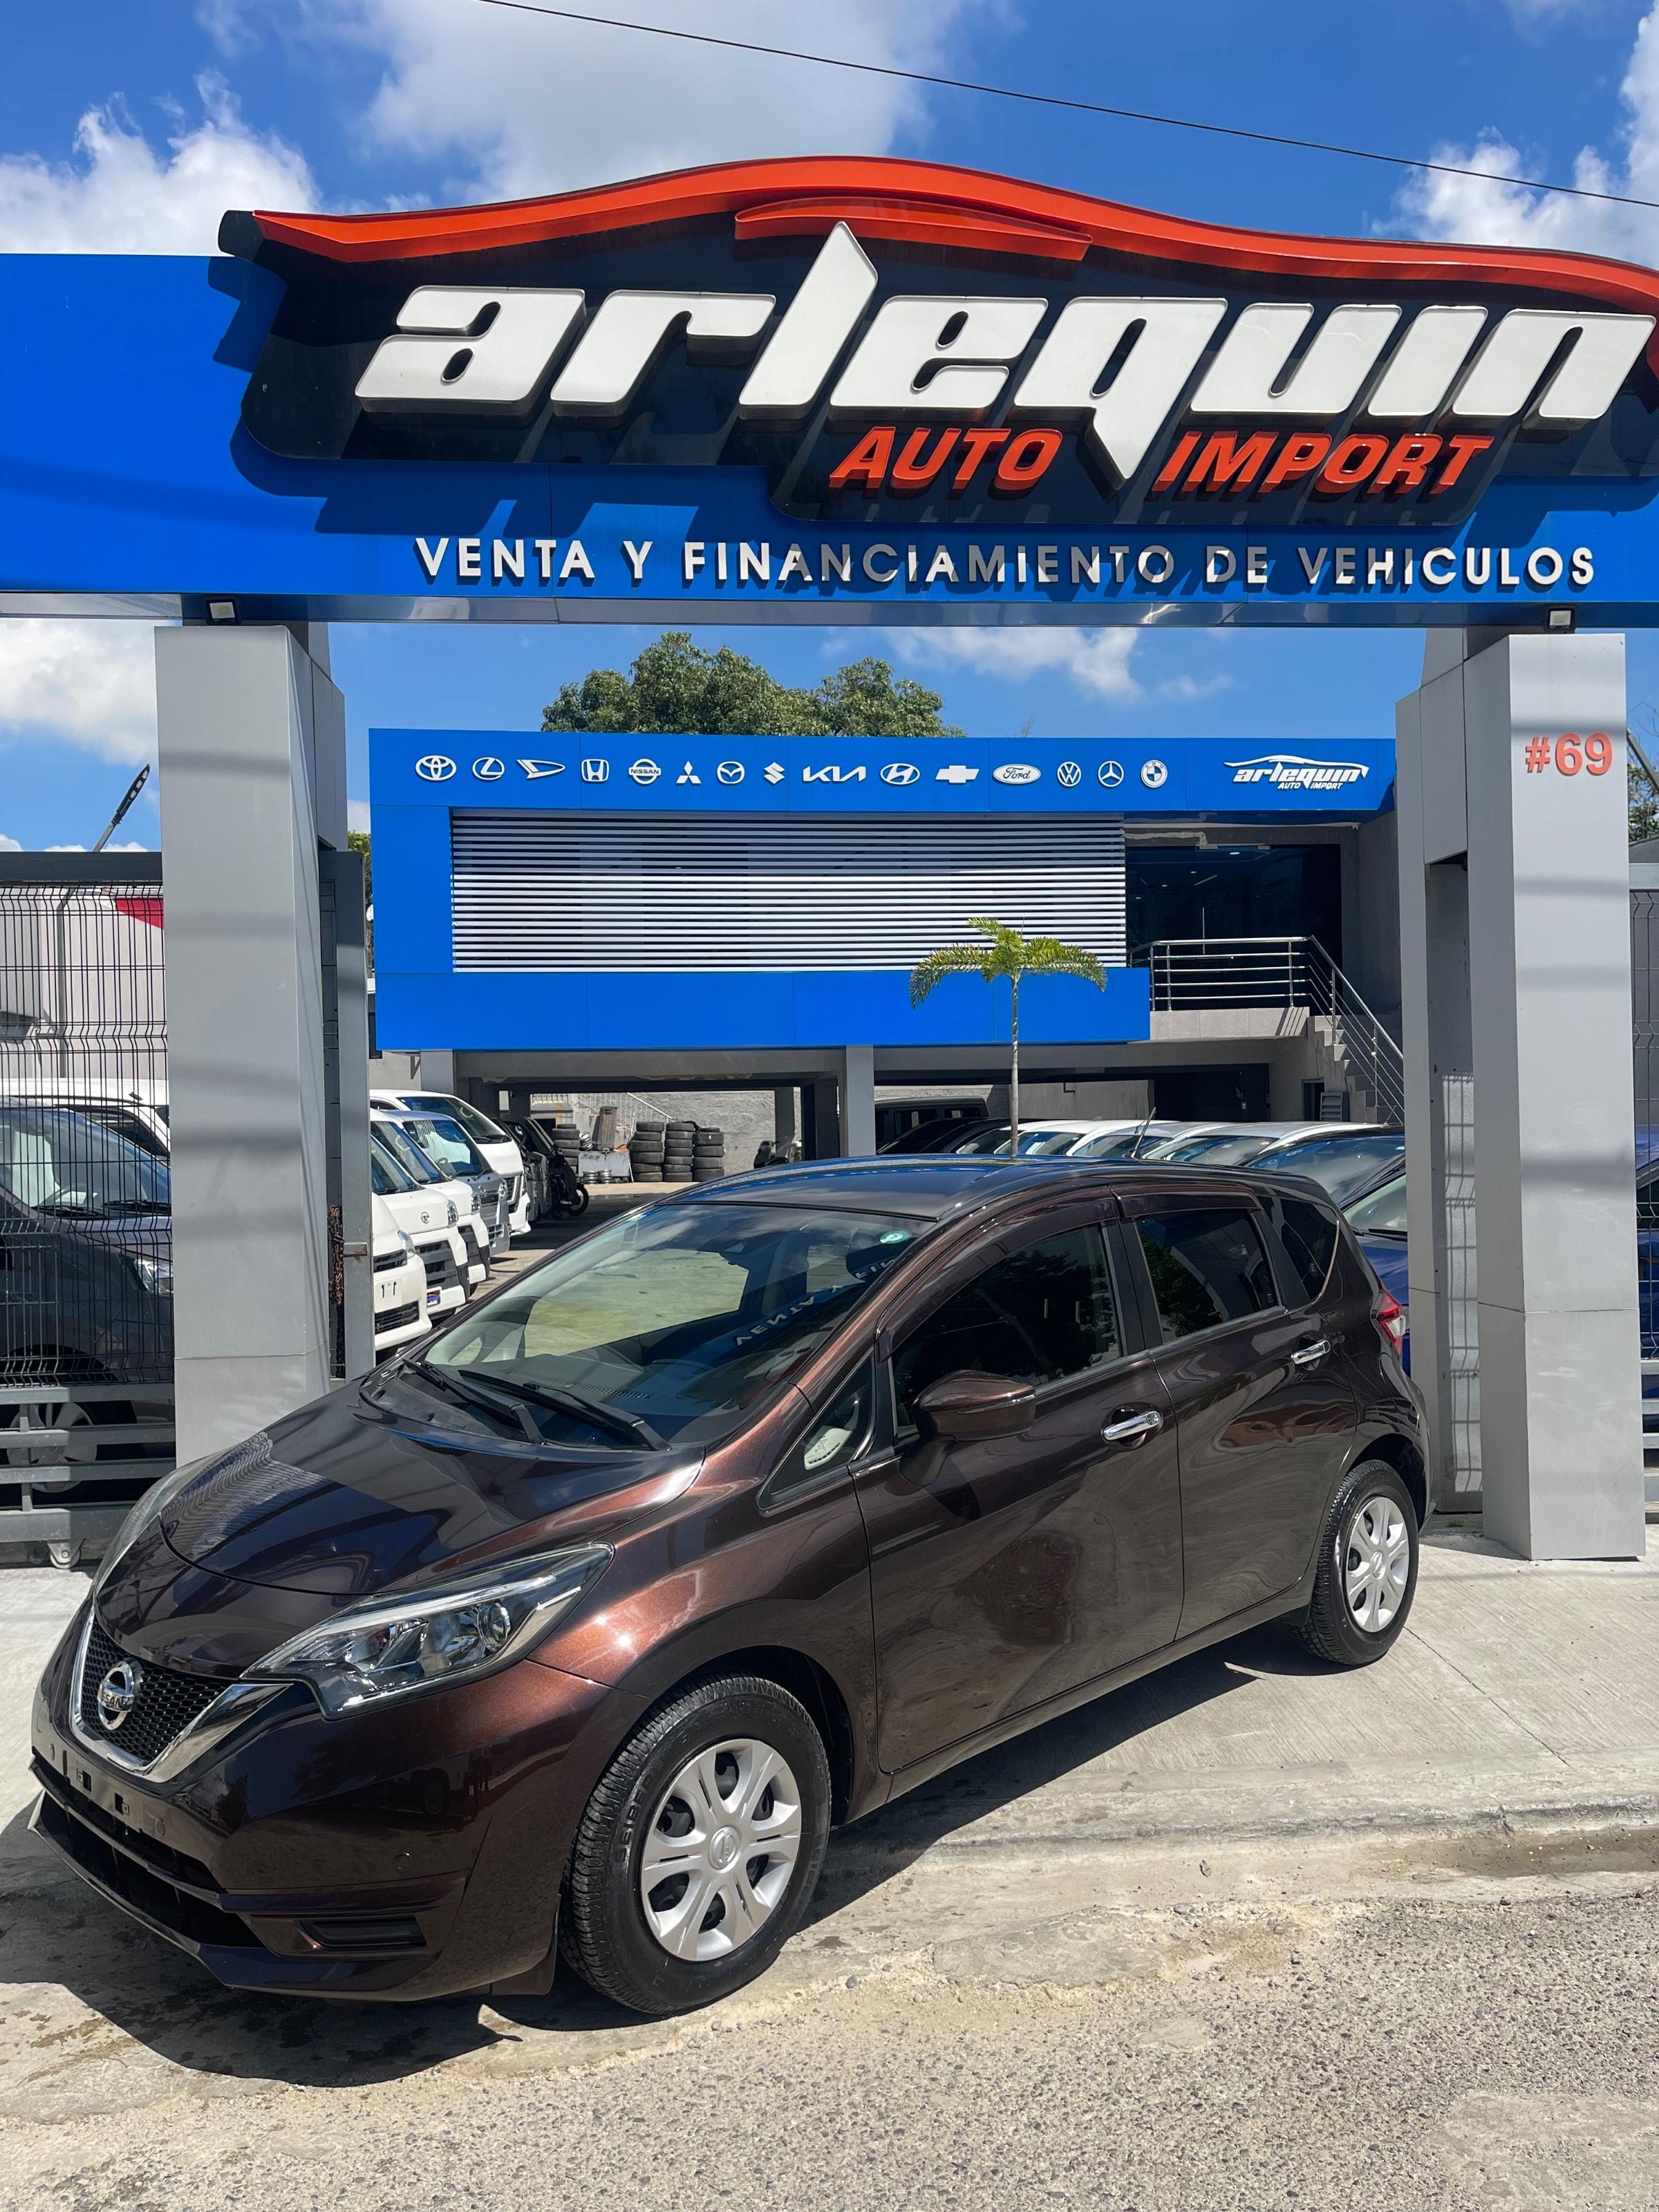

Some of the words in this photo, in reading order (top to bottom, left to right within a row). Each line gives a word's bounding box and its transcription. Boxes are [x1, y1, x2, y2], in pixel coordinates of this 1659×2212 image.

[355, 221, 1657, 484] arlequin
[830, 425, 1063, 492] AUTO
[1152, 430, 1495, 494] IMPORT
[415, 537, 595, 580] VENTA
[624, 540, 653, 580] Y
[684, 541, 1175, 584] FINANCIAMIENTO
[1206, 546, 1268, 584] DE
[1297, 546, 1594, 586] VEHICULOS
[1003, 767, 1031, 779] Ford
[1525, 733, 1613, 776] #69
[1277, 782, 1301, 790] AUTO
[1310, 782, 1343, 791] IMPORT
